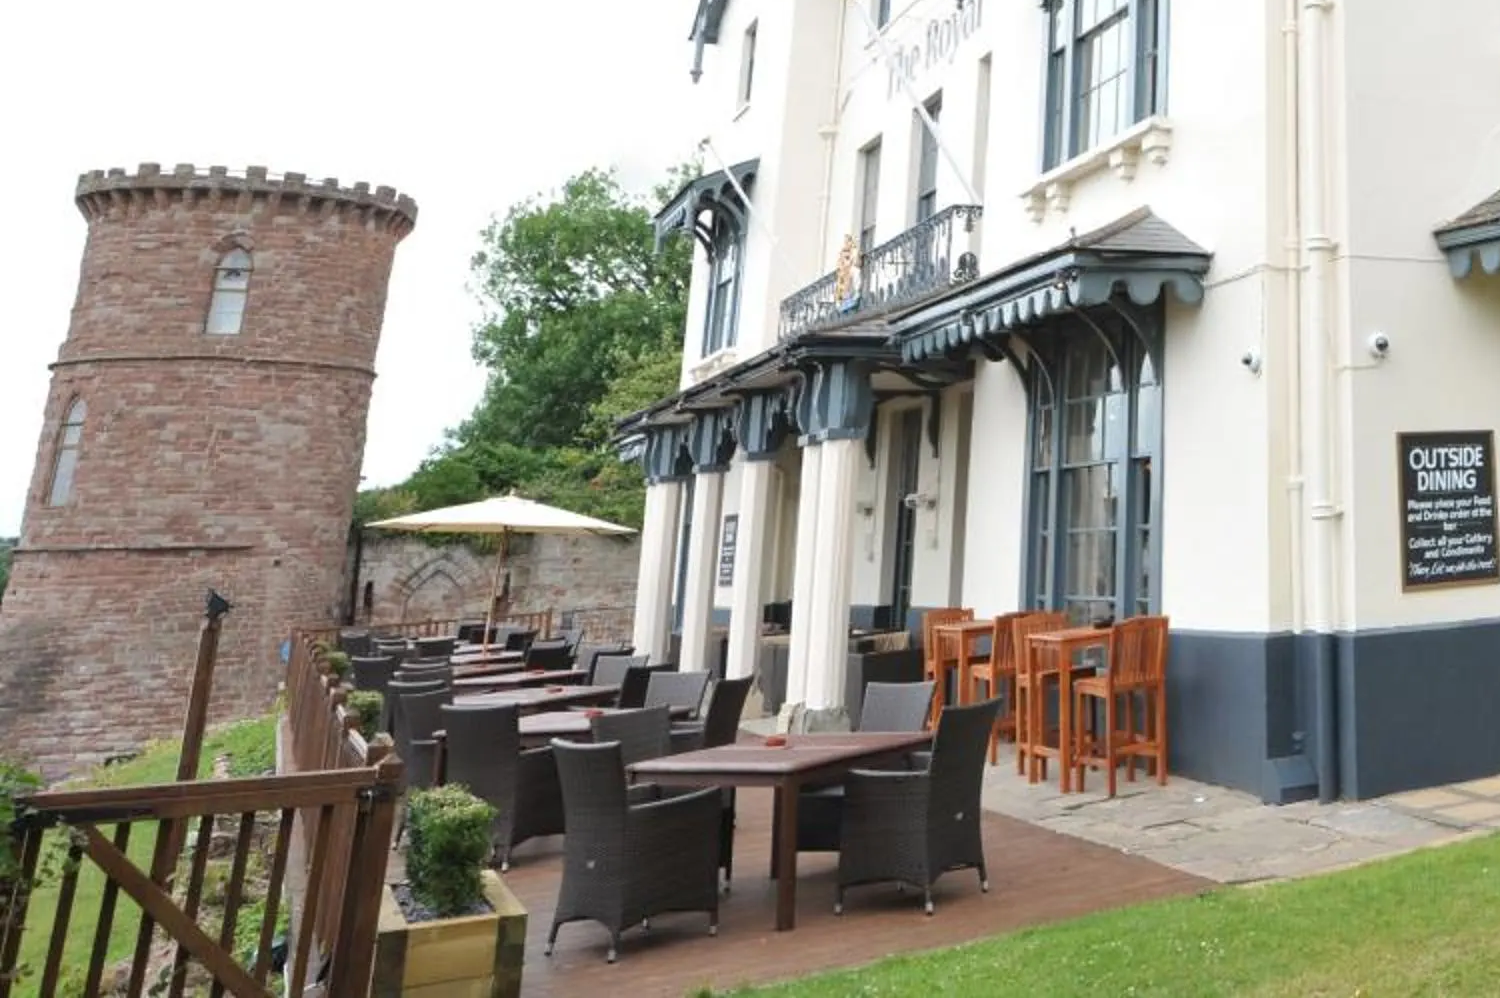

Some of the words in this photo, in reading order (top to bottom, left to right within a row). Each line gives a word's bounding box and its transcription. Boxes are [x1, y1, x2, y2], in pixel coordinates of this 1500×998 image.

[886, 44, 920, 103] The
[1409, 446, 1484, 470] OUTSIDE
[1417, 469, 1477, 492] DINING
[1473, 494, 1493, 506] Food
[1407, 511, 1422, 523] and
[1471, 509, 1479, 518] at
[1479, 507, 1492, 517] the
[1407, 537, 1436, 549] Collect
[1437, 535, 1447, 547] all
[1424, 548, 1440, 559] and
